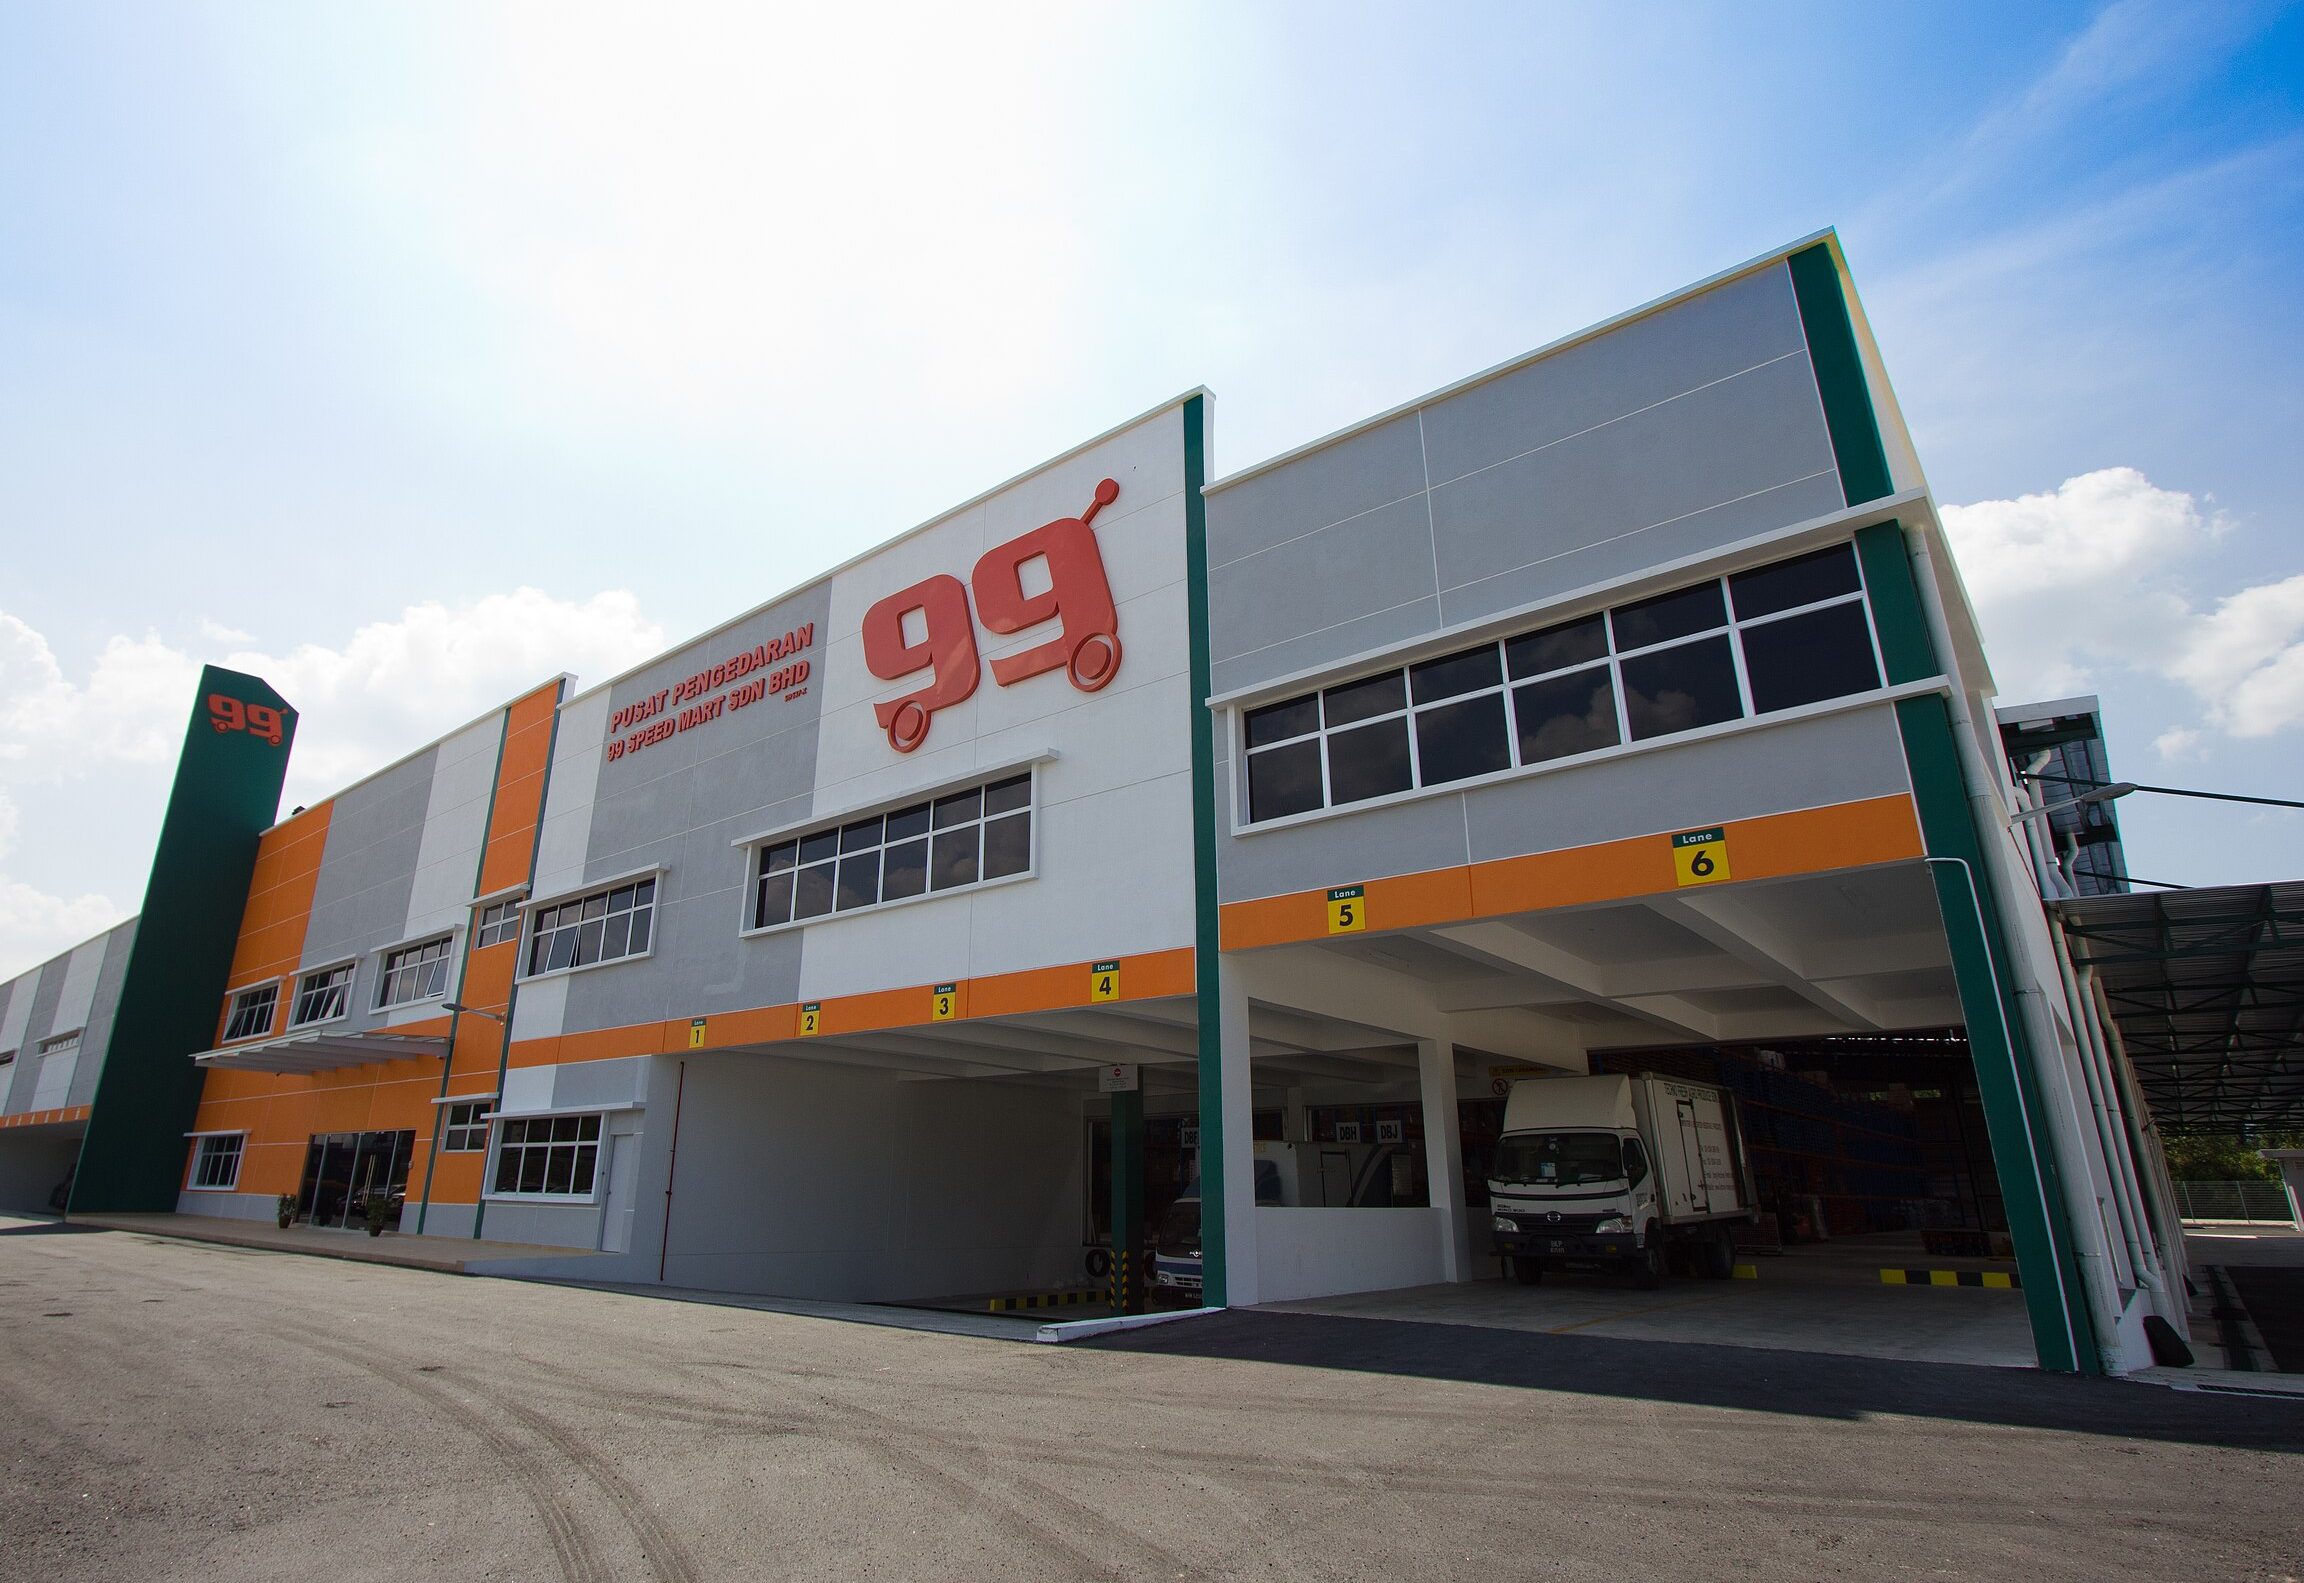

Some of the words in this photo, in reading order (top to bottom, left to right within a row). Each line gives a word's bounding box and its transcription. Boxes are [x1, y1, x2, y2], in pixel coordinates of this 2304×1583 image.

[862, 478, 1122, 754] 99
[610, 688, 669, 733] PUSAT
[672, 622, 814, 706] PENGEDARAN
[607, 739, 625, 761] 99
[627, 718, 675, 753] SPEED
[677, 695, 726, 733] MART
[728, 677, 766, 711] SDN
[768, 659, 810, 694] BHD
[1683, 833, 1712, 845] Lane
[1691, 850, 1714, 877] 6
[1334, 888, 1355, 898] Lane
[1339, 904, 1353, 926] 5
[1097, 963, 1114, 971] Lane
[938, 985, 951, 993] Lane
[1099, 976, 1111, 995] 4
[940, 997, 949, 1015] 3
[806, 1015, 814, 1031] 2
[695, 1030, 700, 1043] 1
[1339, 1126, 1357, 1140] DBH
[1380, 1124, 1398, 1139] DBJ
